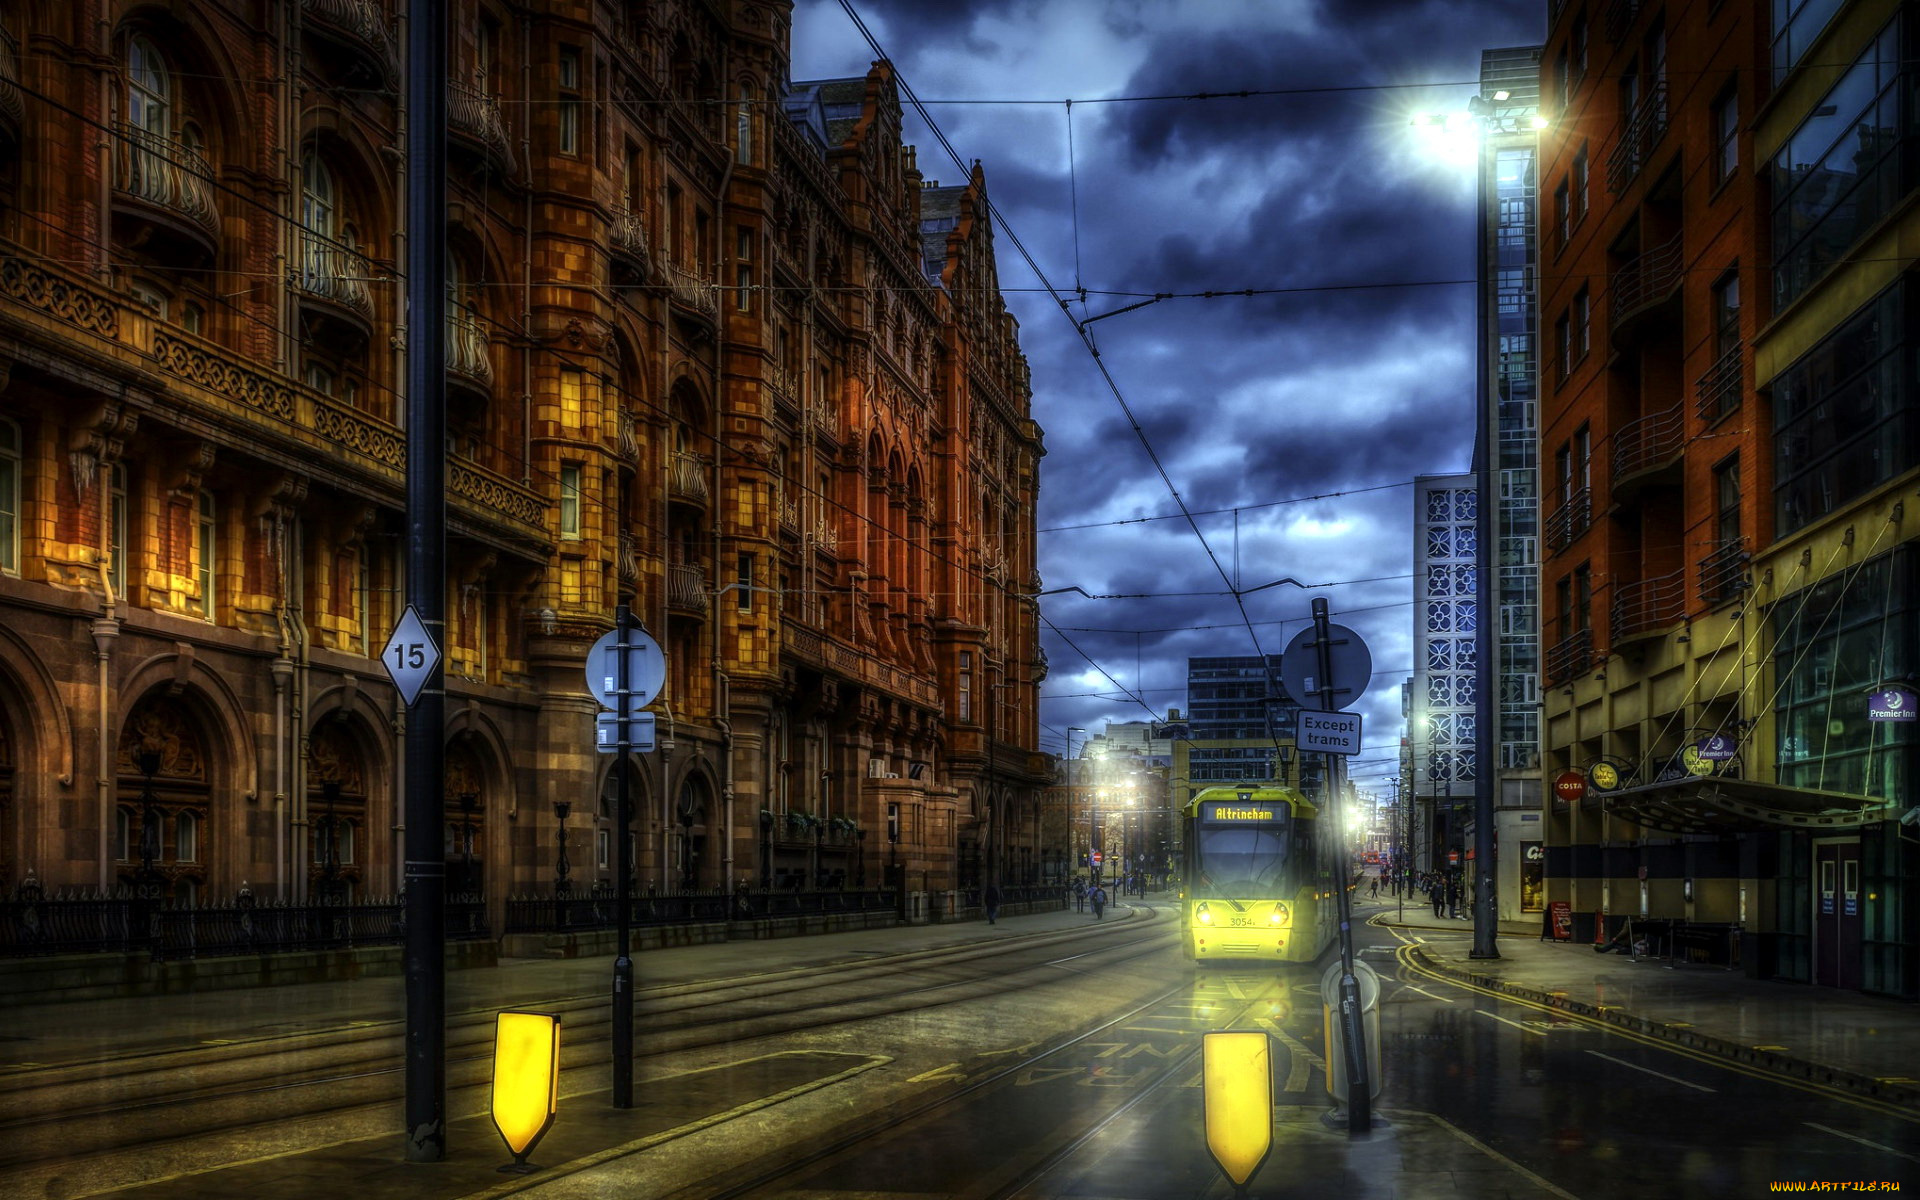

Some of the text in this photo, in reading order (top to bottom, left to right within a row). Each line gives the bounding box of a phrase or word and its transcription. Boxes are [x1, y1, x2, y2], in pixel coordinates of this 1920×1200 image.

[394, 643, 425, 669] 15
[1870, 709, 1916, 718] Premier Inn
[1304, 716, 1355, 733] Except
[1307, 732, 1350, 747] trams
[1216, 807, 1273, 820] Altrincham
[1230, 917, 1252, 926] 3054
